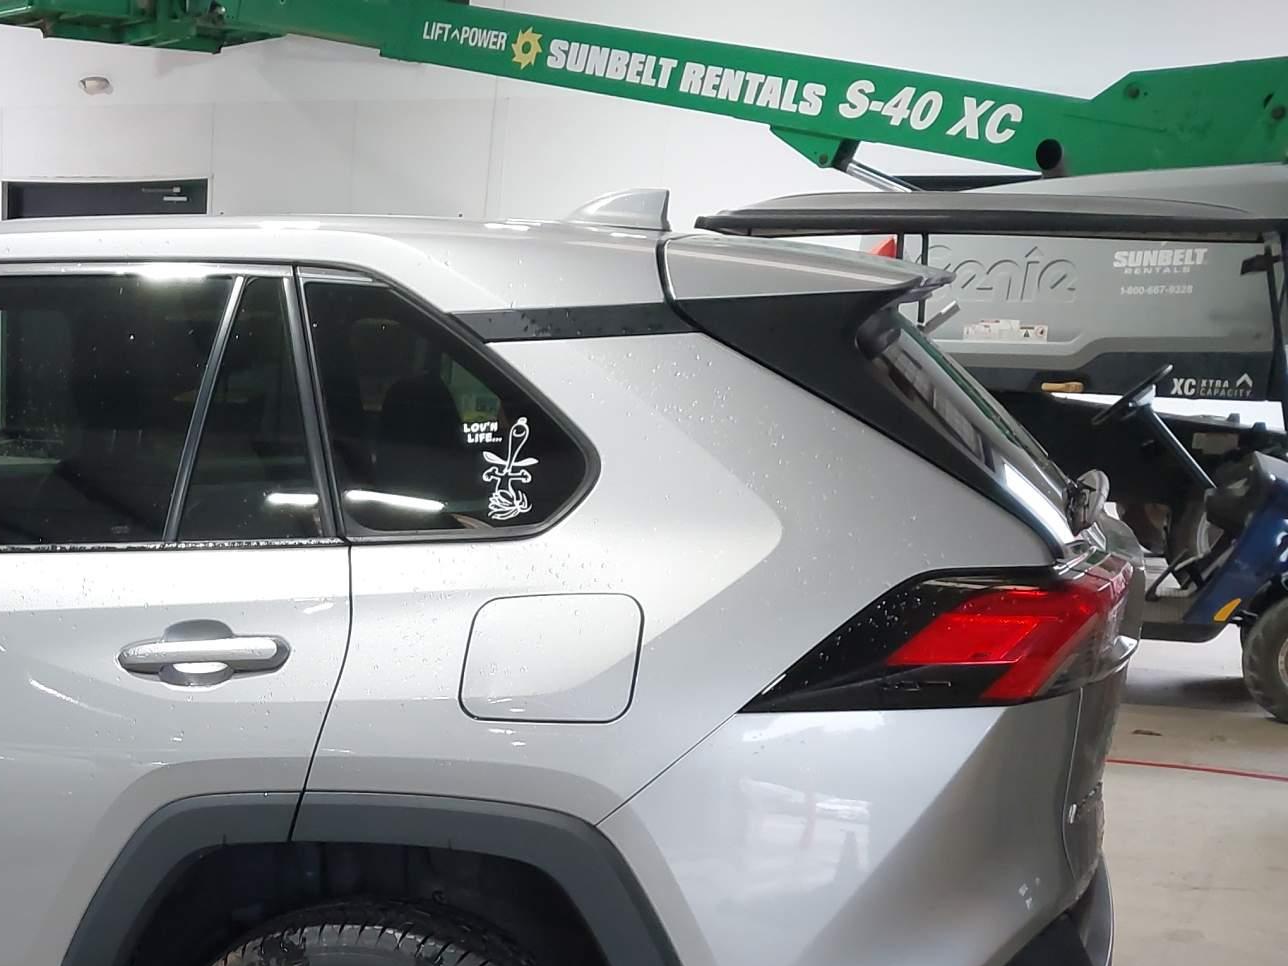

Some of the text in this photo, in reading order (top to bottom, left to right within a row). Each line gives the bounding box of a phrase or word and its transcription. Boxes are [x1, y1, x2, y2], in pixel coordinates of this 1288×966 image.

[546, 38, 827, 116] SUNBELT RENTALS
[838, 79, 1024, 144] S-40 XC
[1112, 248, 1208, 268] SUNBELT
[1123, 266, 1191, 275] RENTALS
[1170, 378, 1197, 396] XC
[1199, 387, 1252, 398] CAPACITY
[1201, 379, 1229, 388] XTRA
